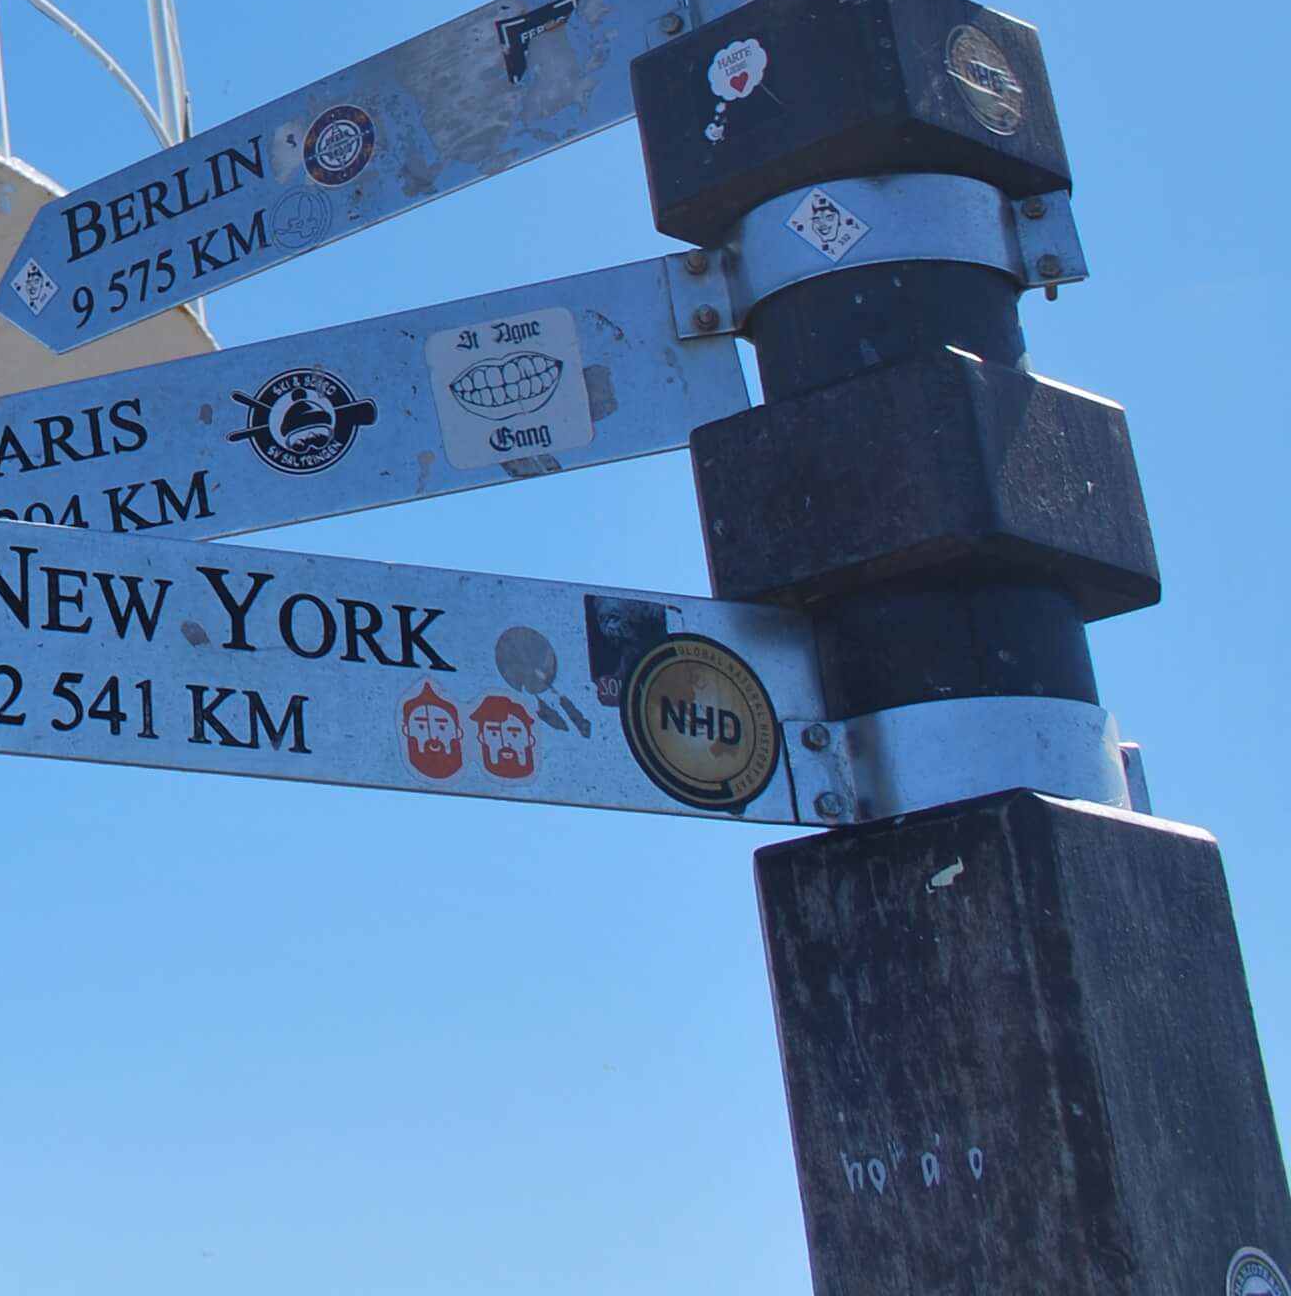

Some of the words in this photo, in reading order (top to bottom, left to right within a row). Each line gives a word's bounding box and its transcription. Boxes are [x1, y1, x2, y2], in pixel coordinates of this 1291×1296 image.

[61, 135, 264, 264] BERLIN
[72, 286, 95, 329] 9
[108, 249, 176, 313] 575
[187, 208, 272, 280] KM
[272, 379, 290, 395] SKI
[489, 424, 552, 452] Gang
[102, 470, 216, 533] KM
[196, 566, 457, 672] YORK
[51, 672, 160, 739] 541
[185, 683, 312, 754] KM
[677, 645, 724, 666] GLOBAL
[728, 662, 765, 719] NATURAL
[661, 696, 741, 745] NHD
